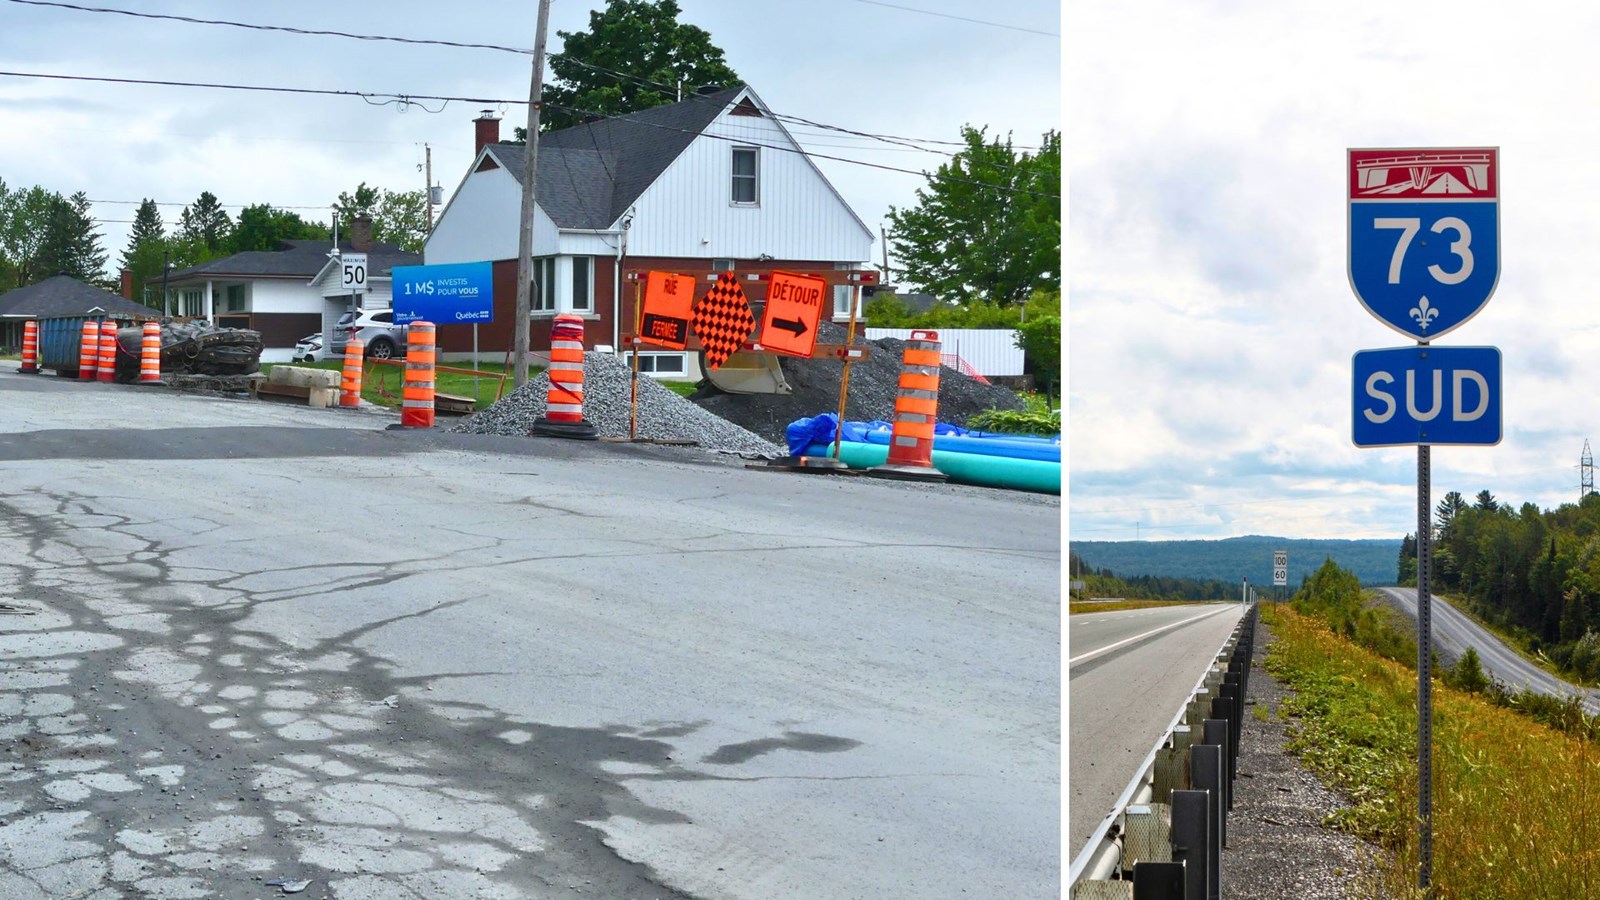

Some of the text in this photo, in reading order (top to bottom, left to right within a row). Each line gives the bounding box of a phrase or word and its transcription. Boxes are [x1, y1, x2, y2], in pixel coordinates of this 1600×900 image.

[1374, 216, 1474, 285] 73
[344, 265, 365, 285] 50
[437, 278, 468, 286] INVESTIS
[404, 280, 434, 296] 1 M$
[437, 287, 479, 296] POUR VOUS
[663, 279, 677, 296] RUE
[773, 280, 819, 306] DÉTOUR
[455, 311, 480, 320] Québec
[652, 320, 678, 339] FERMÉE
[1363, 369, 1490, 424] SUD
[1275, 556, 1286, 566] 100
[1275, 570, 1286, 579] 60
